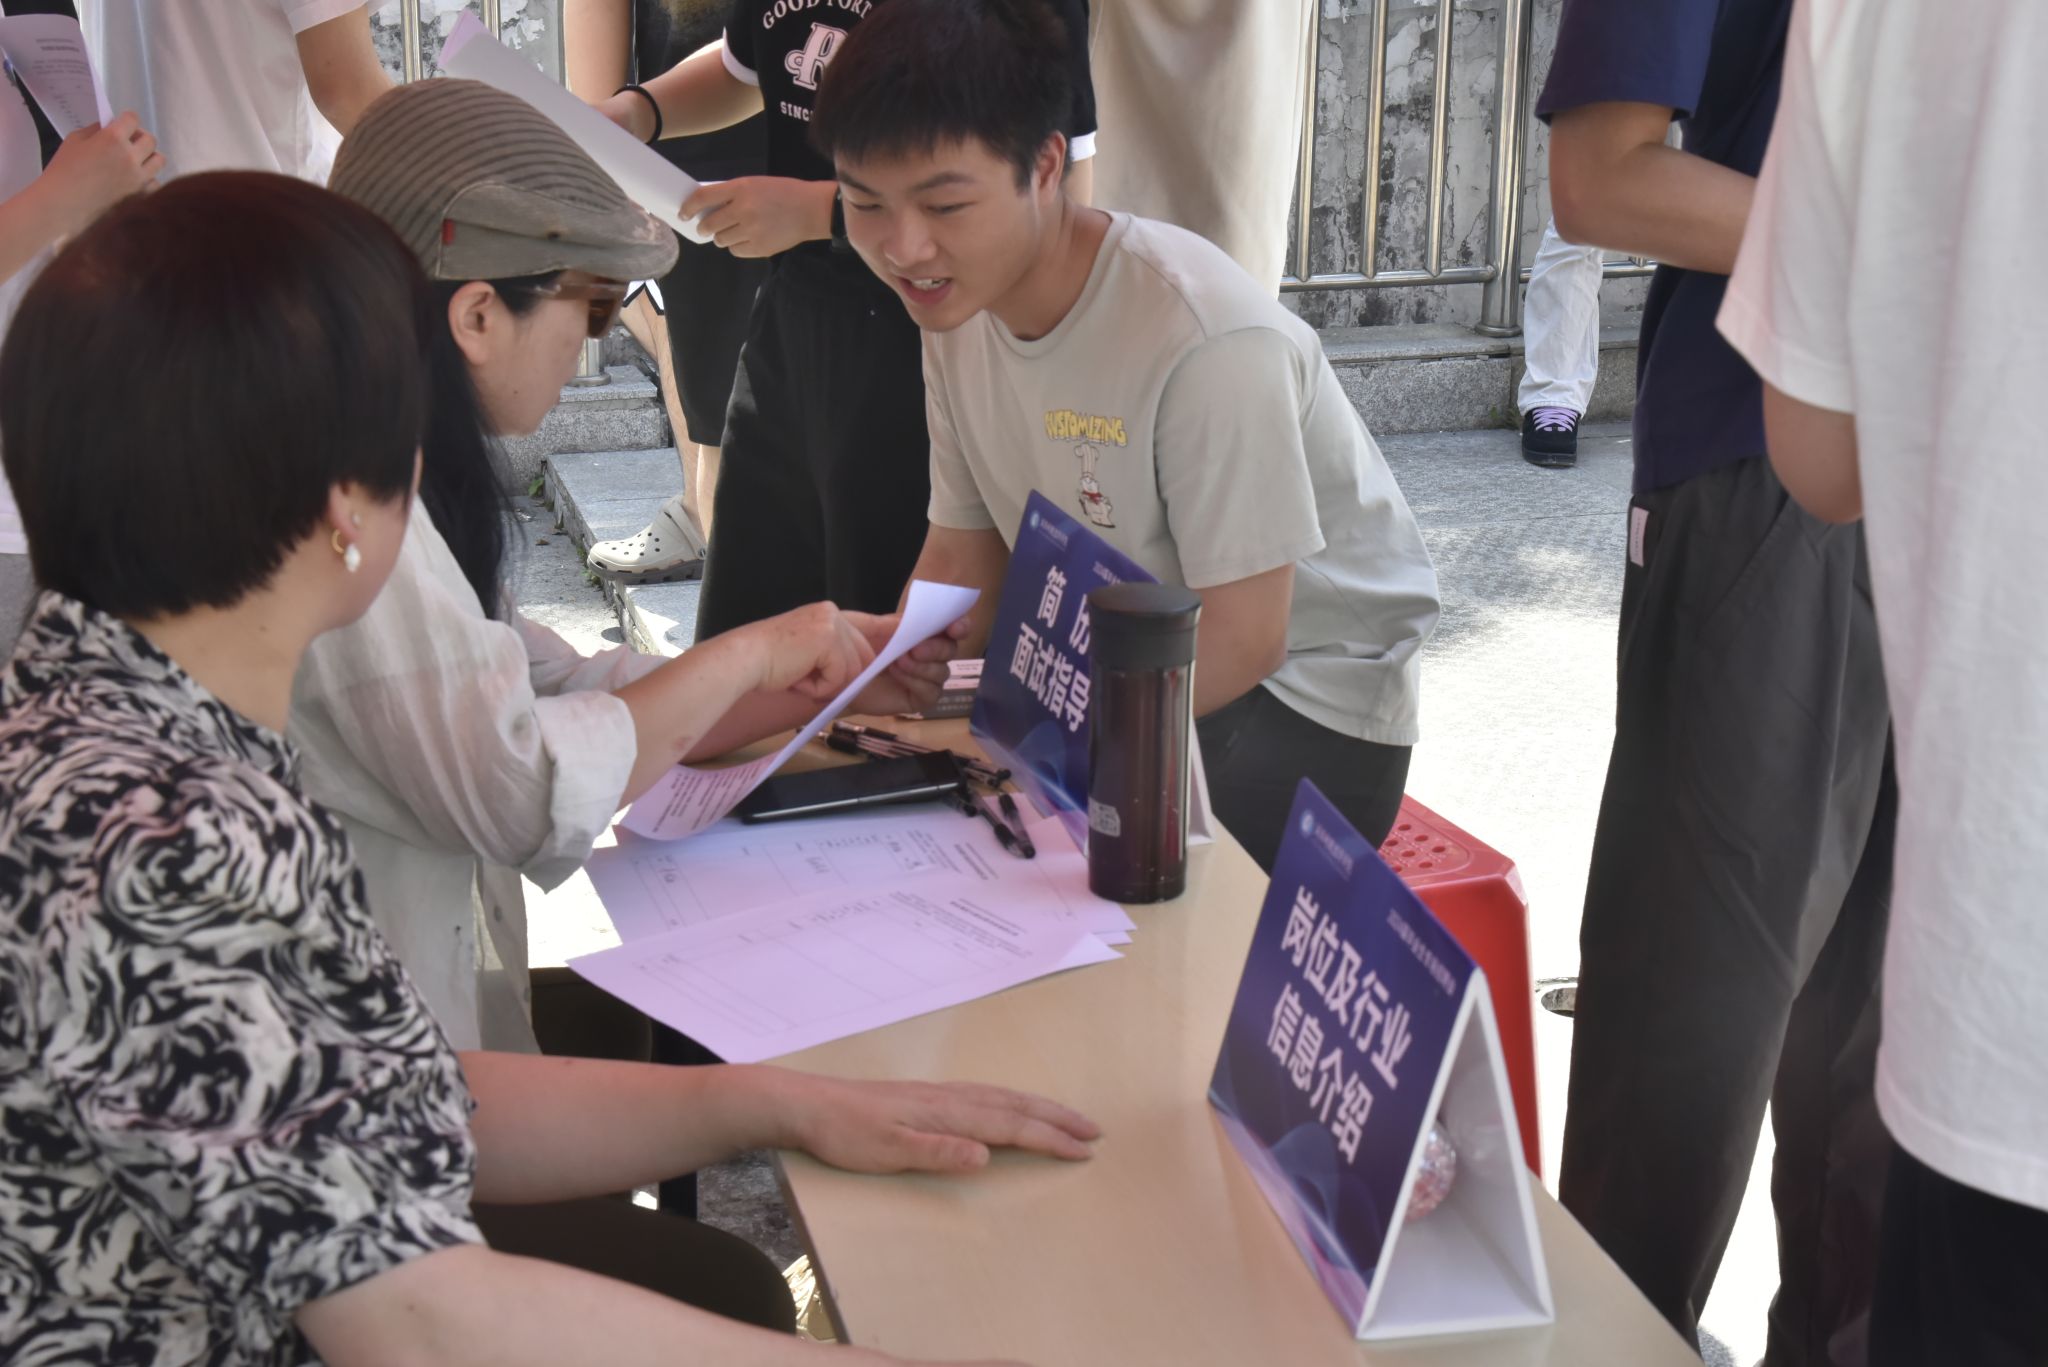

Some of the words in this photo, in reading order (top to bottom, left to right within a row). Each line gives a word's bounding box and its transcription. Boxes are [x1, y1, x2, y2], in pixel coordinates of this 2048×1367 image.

[780, 101, 814, 122] SINC
[1009, 621, 1092, 733] 面试指导
[1280, 885, 1413, 1091] 岗位及行业
[1267, 981, 1374, 1165] 信息介绍
